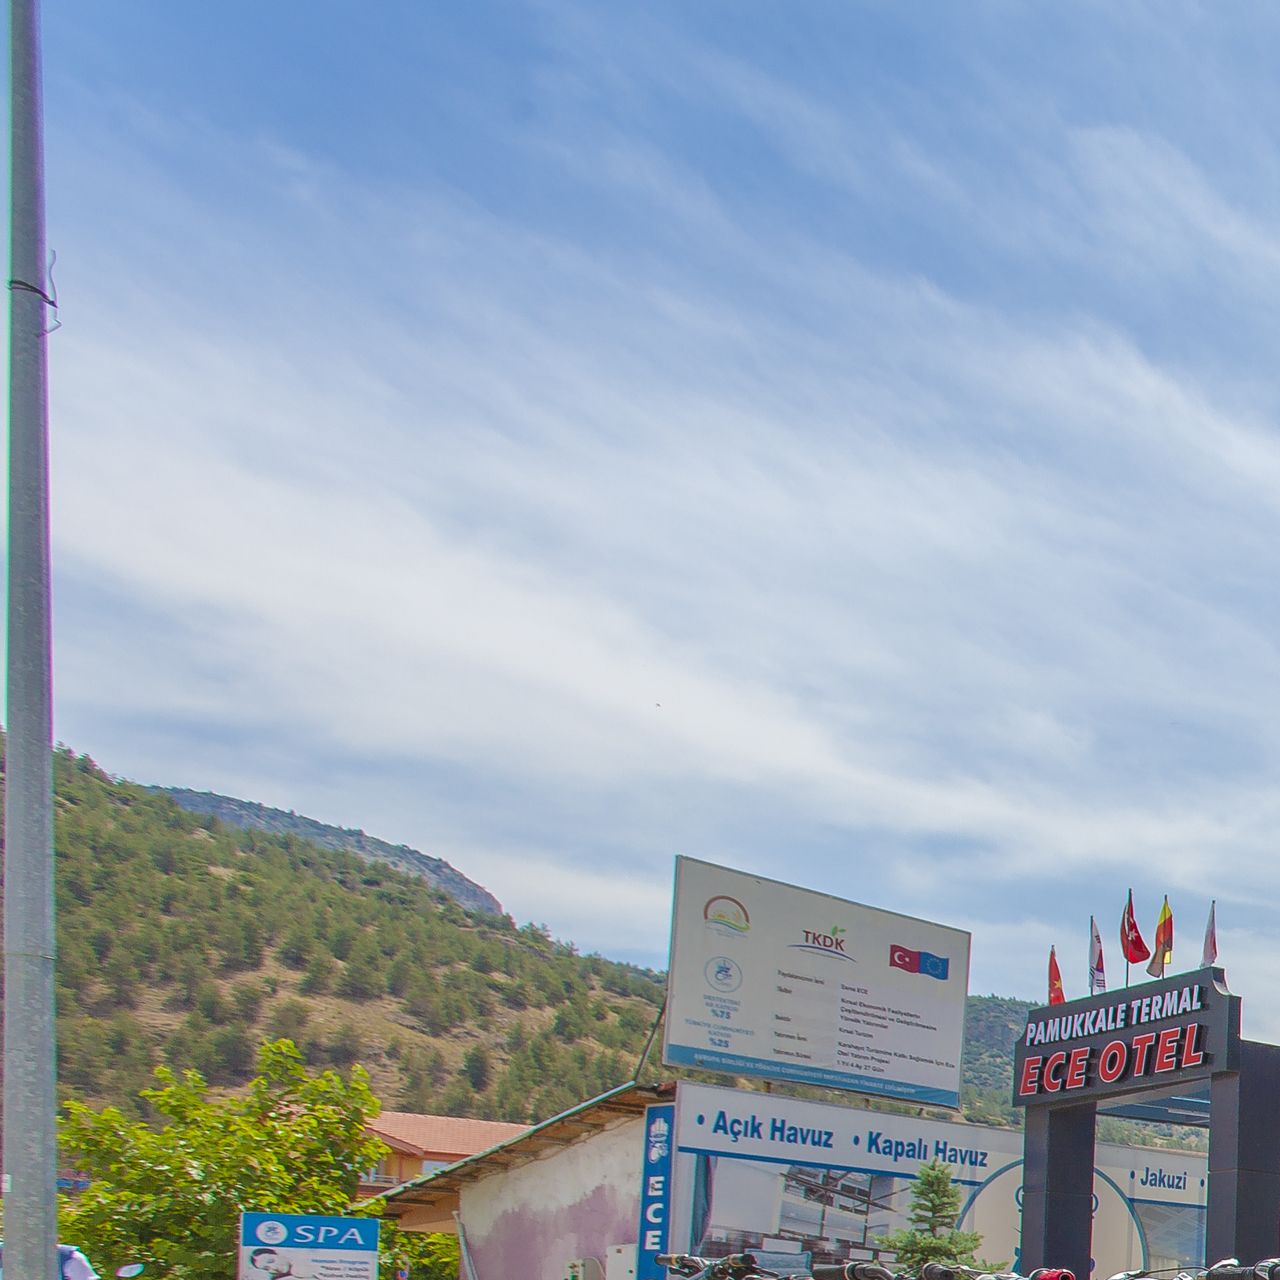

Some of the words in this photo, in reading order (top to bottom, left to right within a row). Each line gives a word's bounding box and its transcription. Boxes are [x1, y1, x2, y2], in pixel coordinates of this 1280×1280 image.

[802, 929, 845, 951] TKDK
[1025, 1002, 1127, 1047] PAMUKKALE
[1130, 984, 1202, 1025] TERMAL
[1019, 1046, 1091, 1096] ECE
[1099, 1023, 1203, 1083] OTEL
[712, 1110, 763, 1143] Açık
[770, 1118, 834, 1149] Havuz
[867, 1130, 928, 1163] Kapalı
[934, 1140, 988, 1167] Havuz
[1140, 1167, 1187, 1190] Jakuzi
[293, 1225, 365, 1245] SPA
[643, 1176, 665, 1250] ECE
